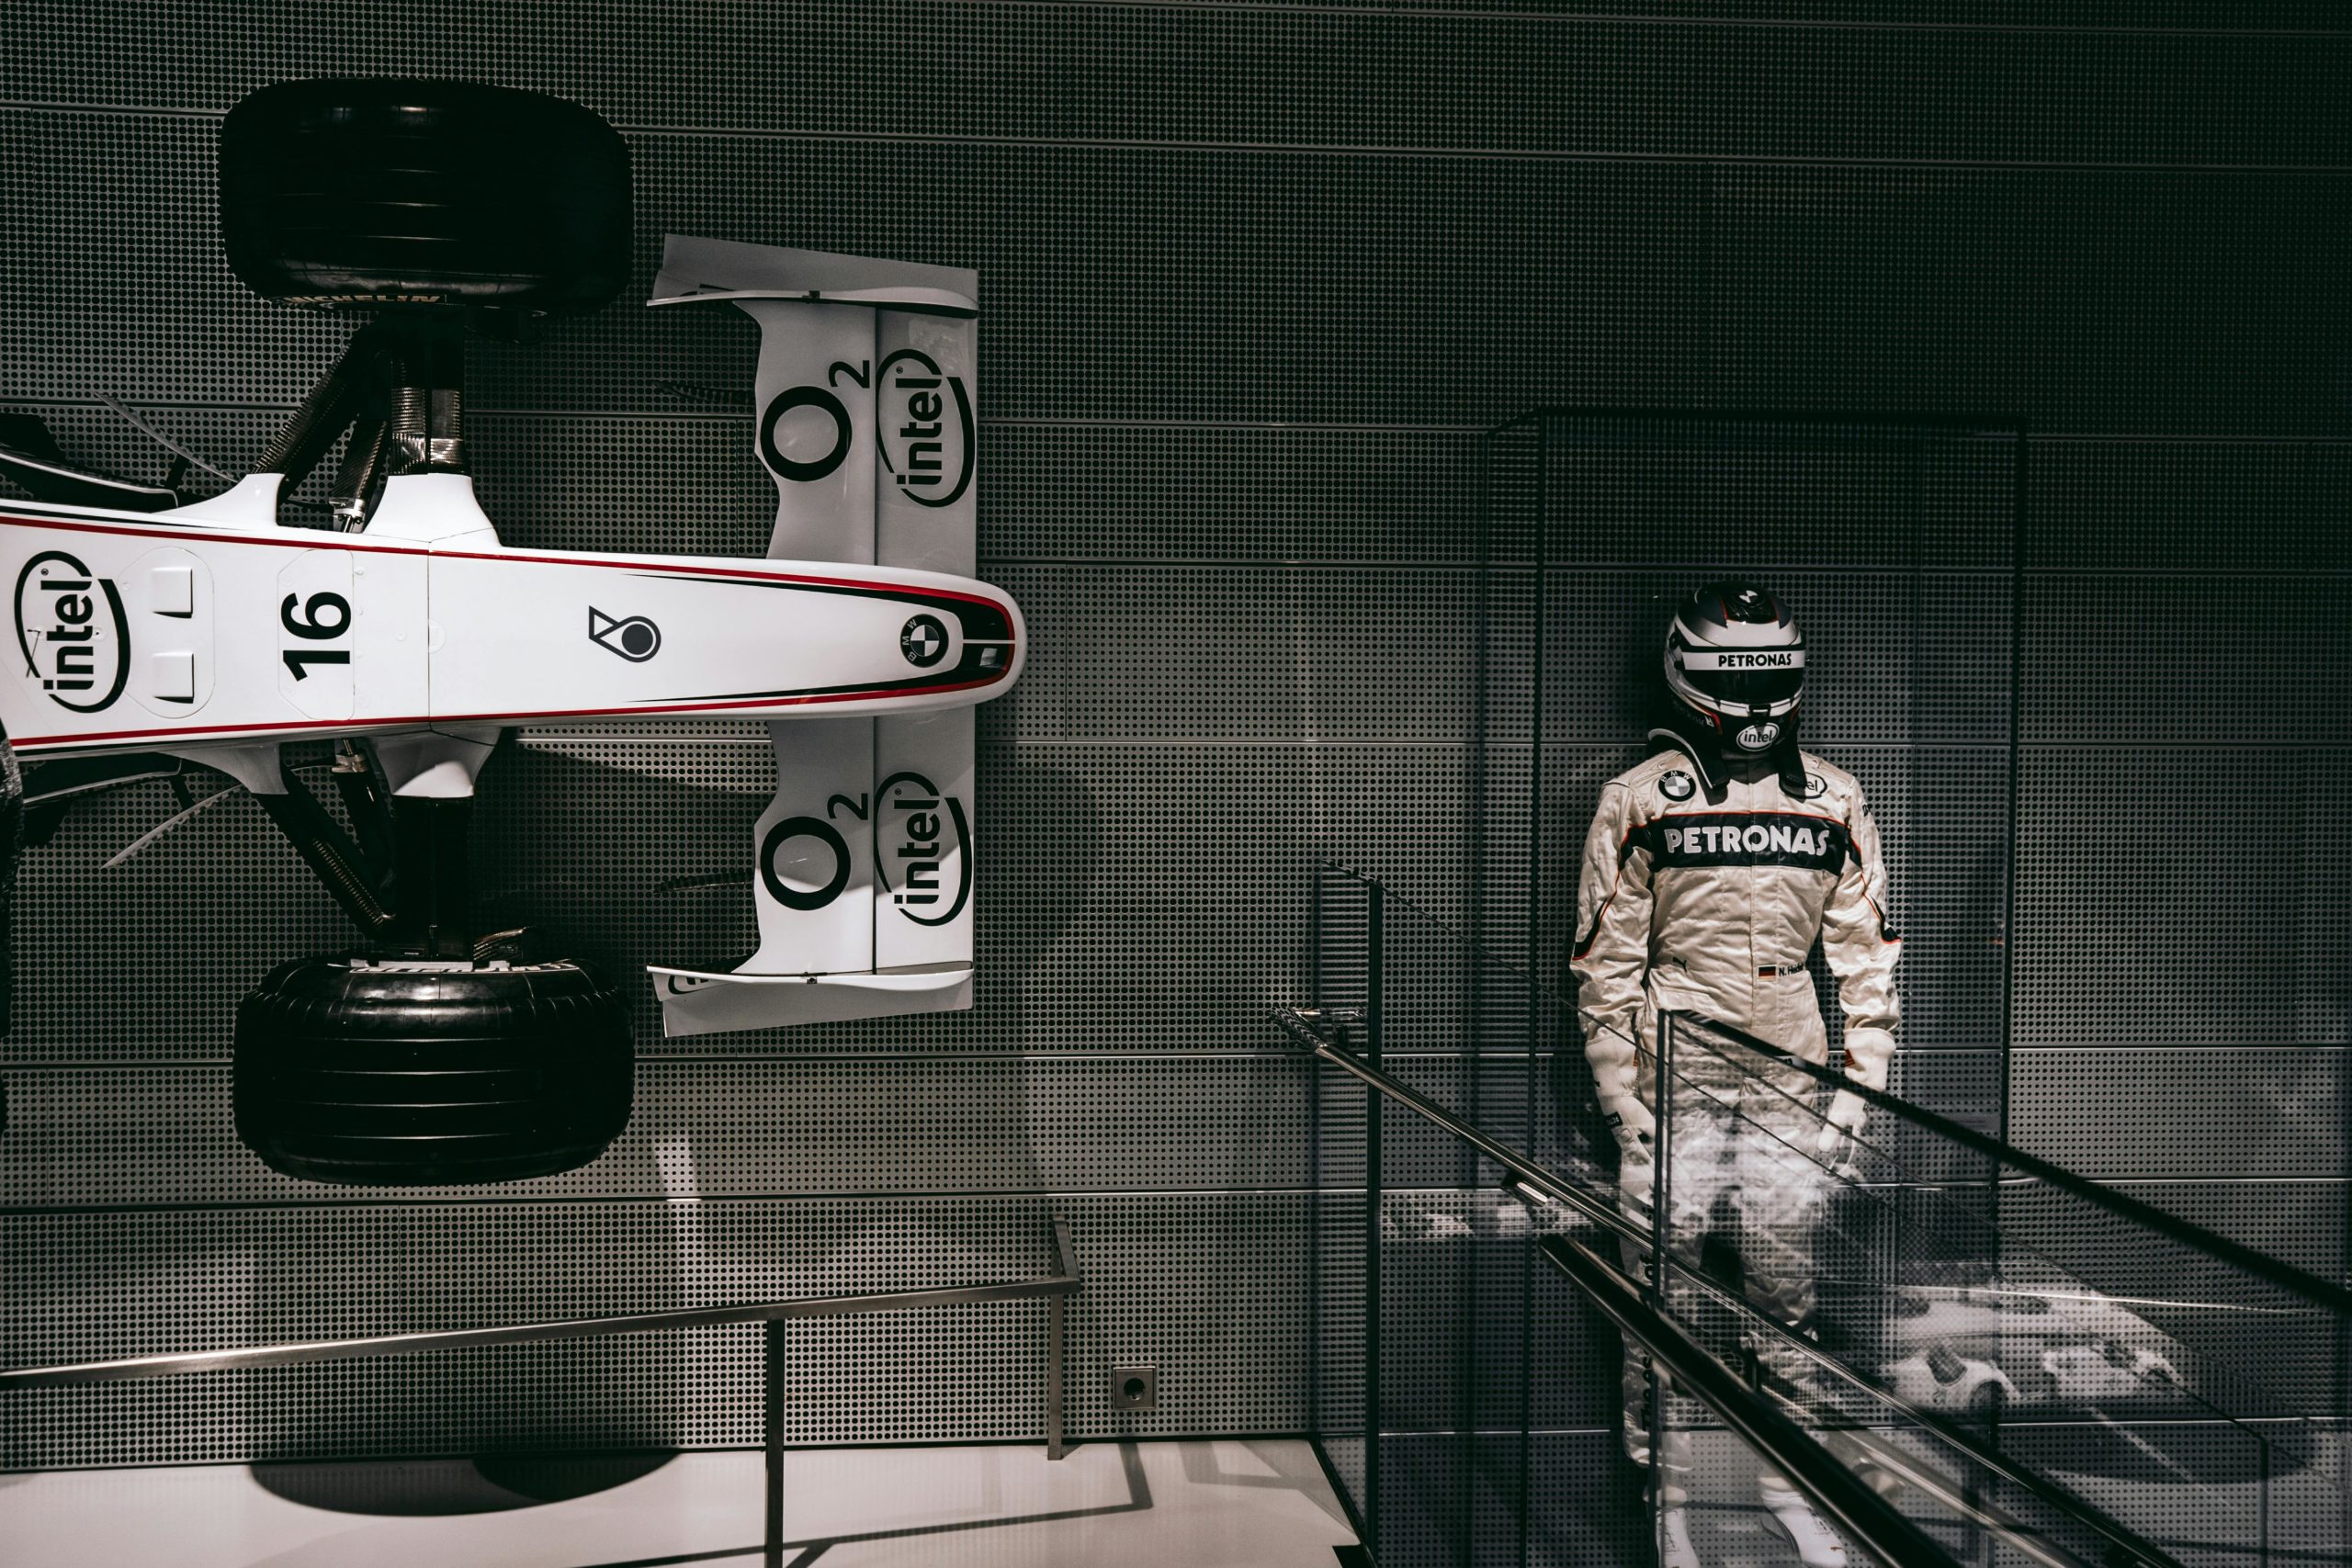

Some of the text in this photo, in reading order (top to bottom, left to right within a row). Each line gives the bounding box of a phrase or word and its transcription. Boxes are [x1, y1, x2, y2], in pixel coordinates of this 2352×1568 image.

[895, 374, 944, 487] intel
[40, 580, 95, 691] intel
[280, 591, 352, 682] 16
[901, 618, 918, 662] BMW
[1718, 652, 1792, 668] PETRONAS
[1743, 729, 1773, 744] intel
[1659, 770, 1691, 783] BMW
[894, 797, 941, 905] intel
[1663, 824, 1830, 857] PETRONAS
